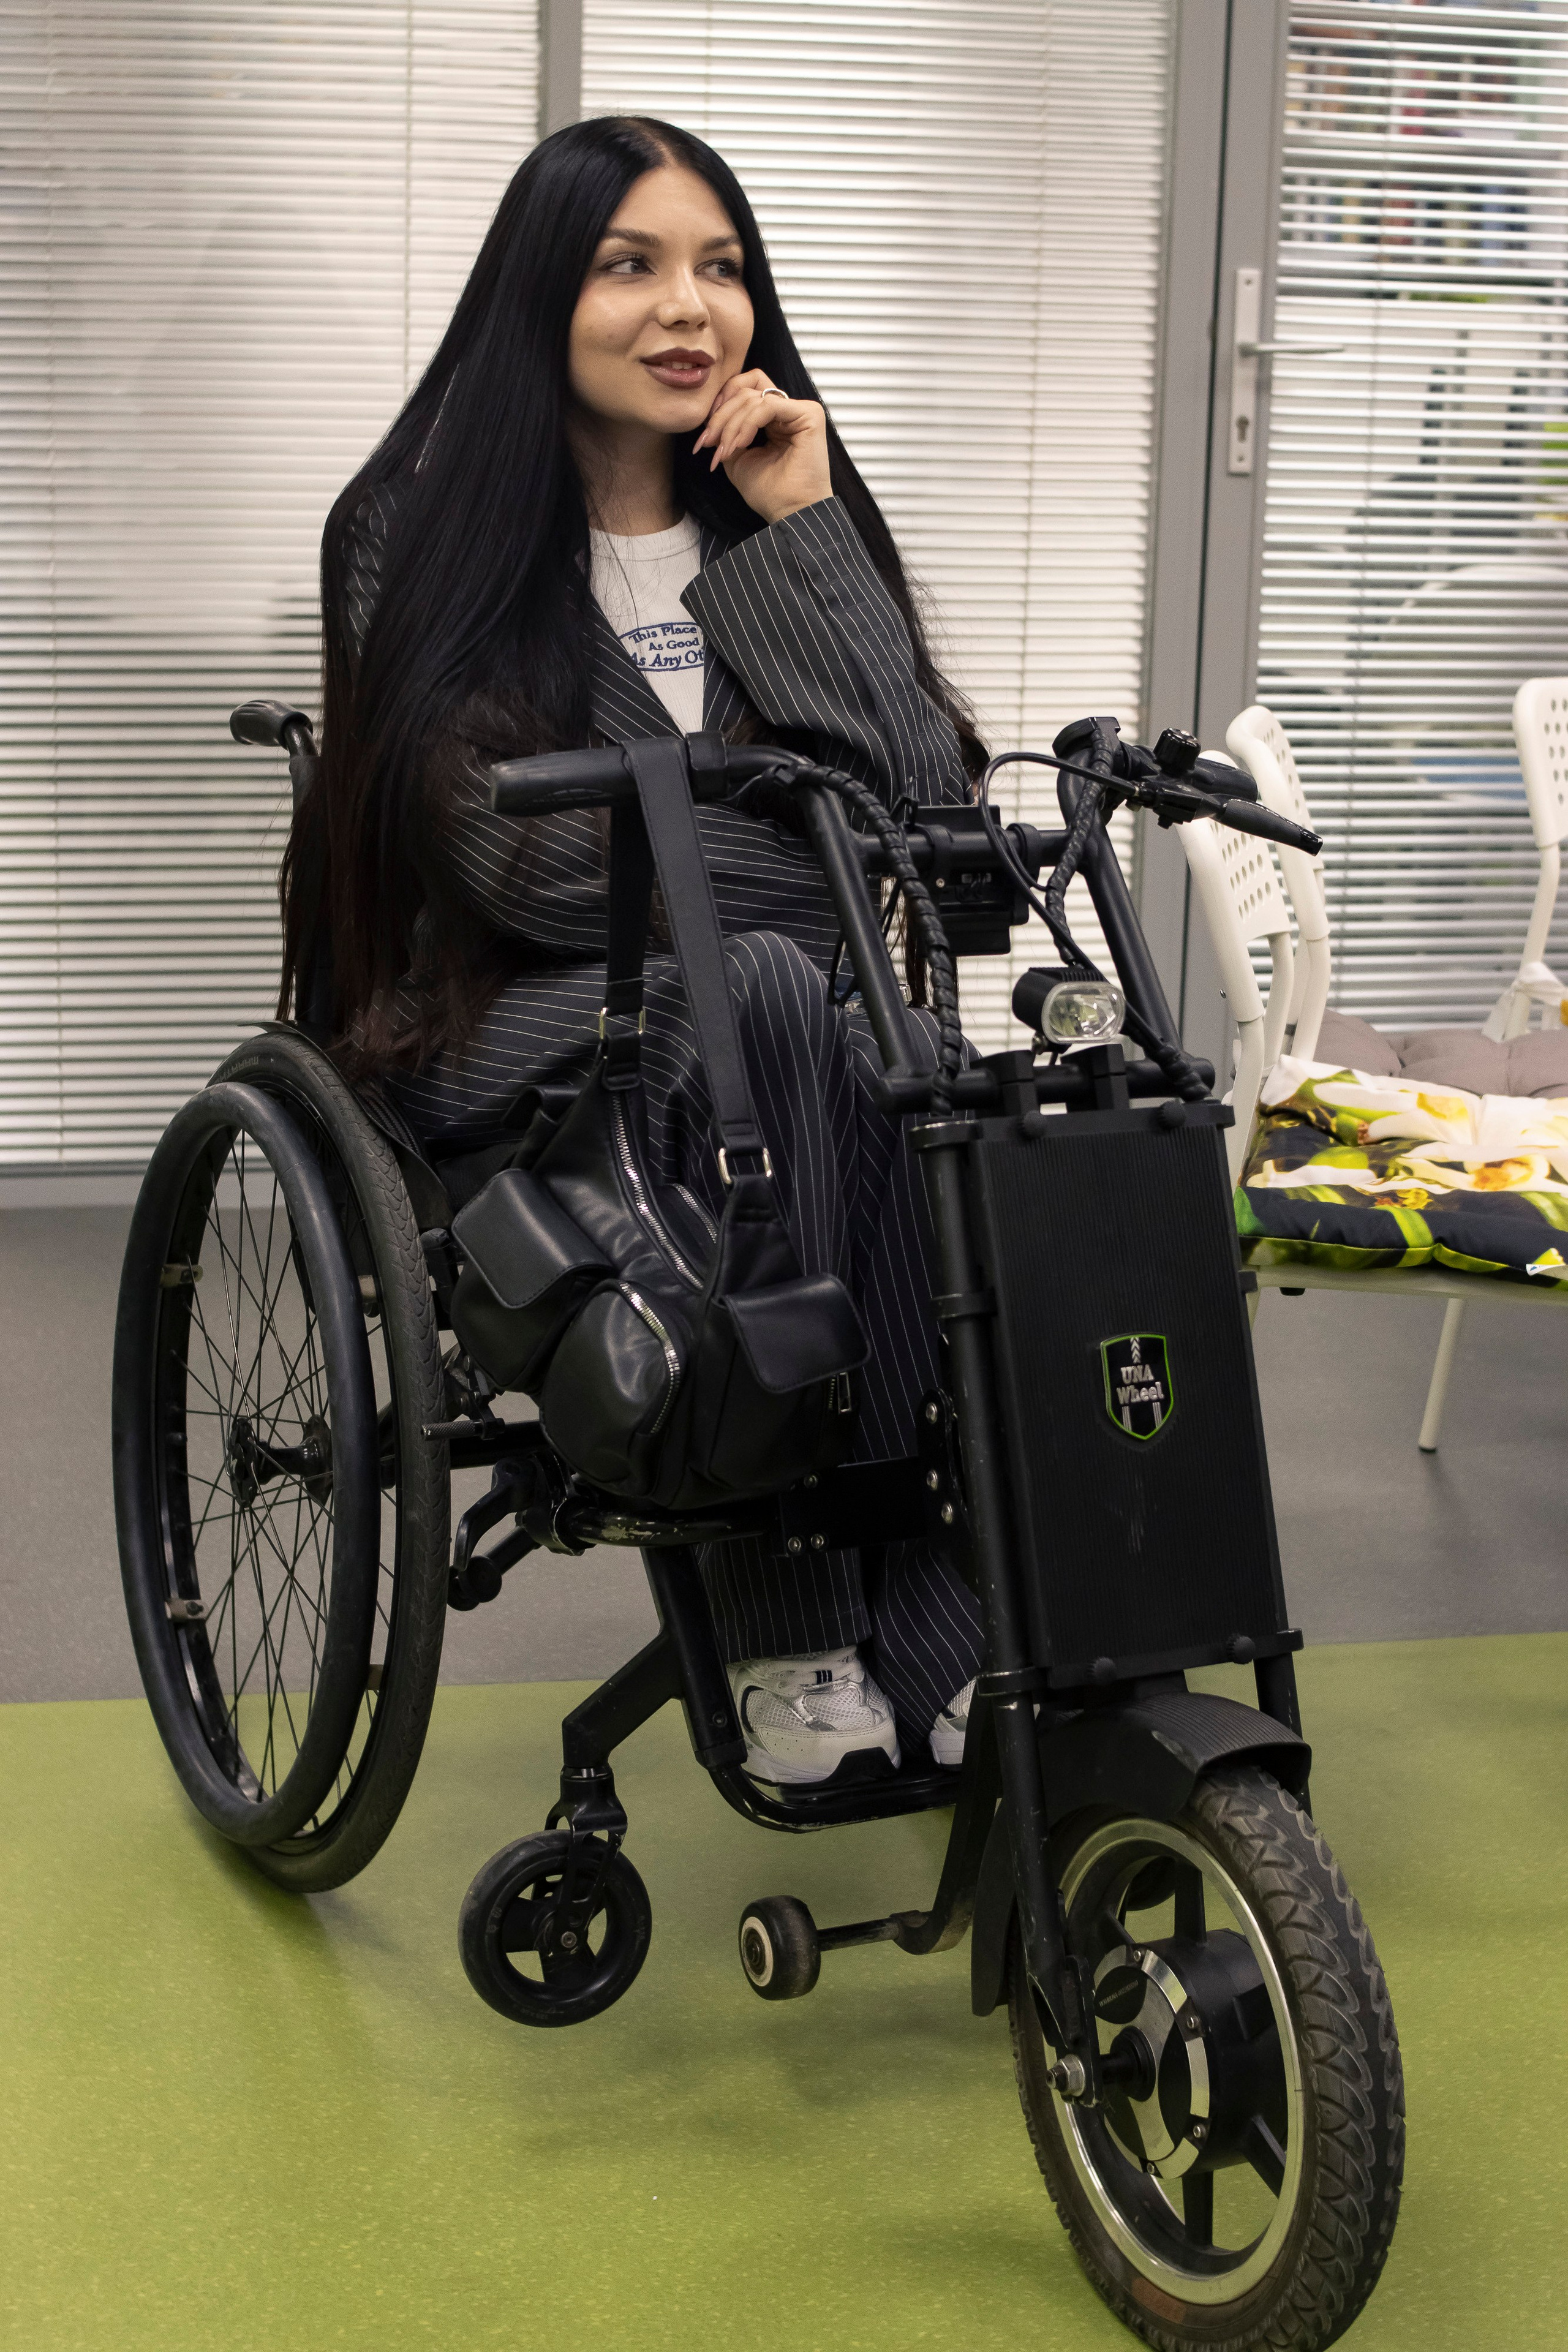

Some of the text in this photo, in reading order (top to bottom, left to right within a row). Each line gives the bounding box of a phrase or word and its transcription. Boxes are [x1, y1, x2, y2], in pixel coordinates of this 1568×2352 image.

[628, 624, 697, 644] This Place
[649, 637, 699, 650] As Good
[649, 653, 682, 668] Any
[685, 646, 704, 663] Ot
[1120, 1364, 1155, 1385] UNA
[1117, 1381, 1164, 1405] Wheel
